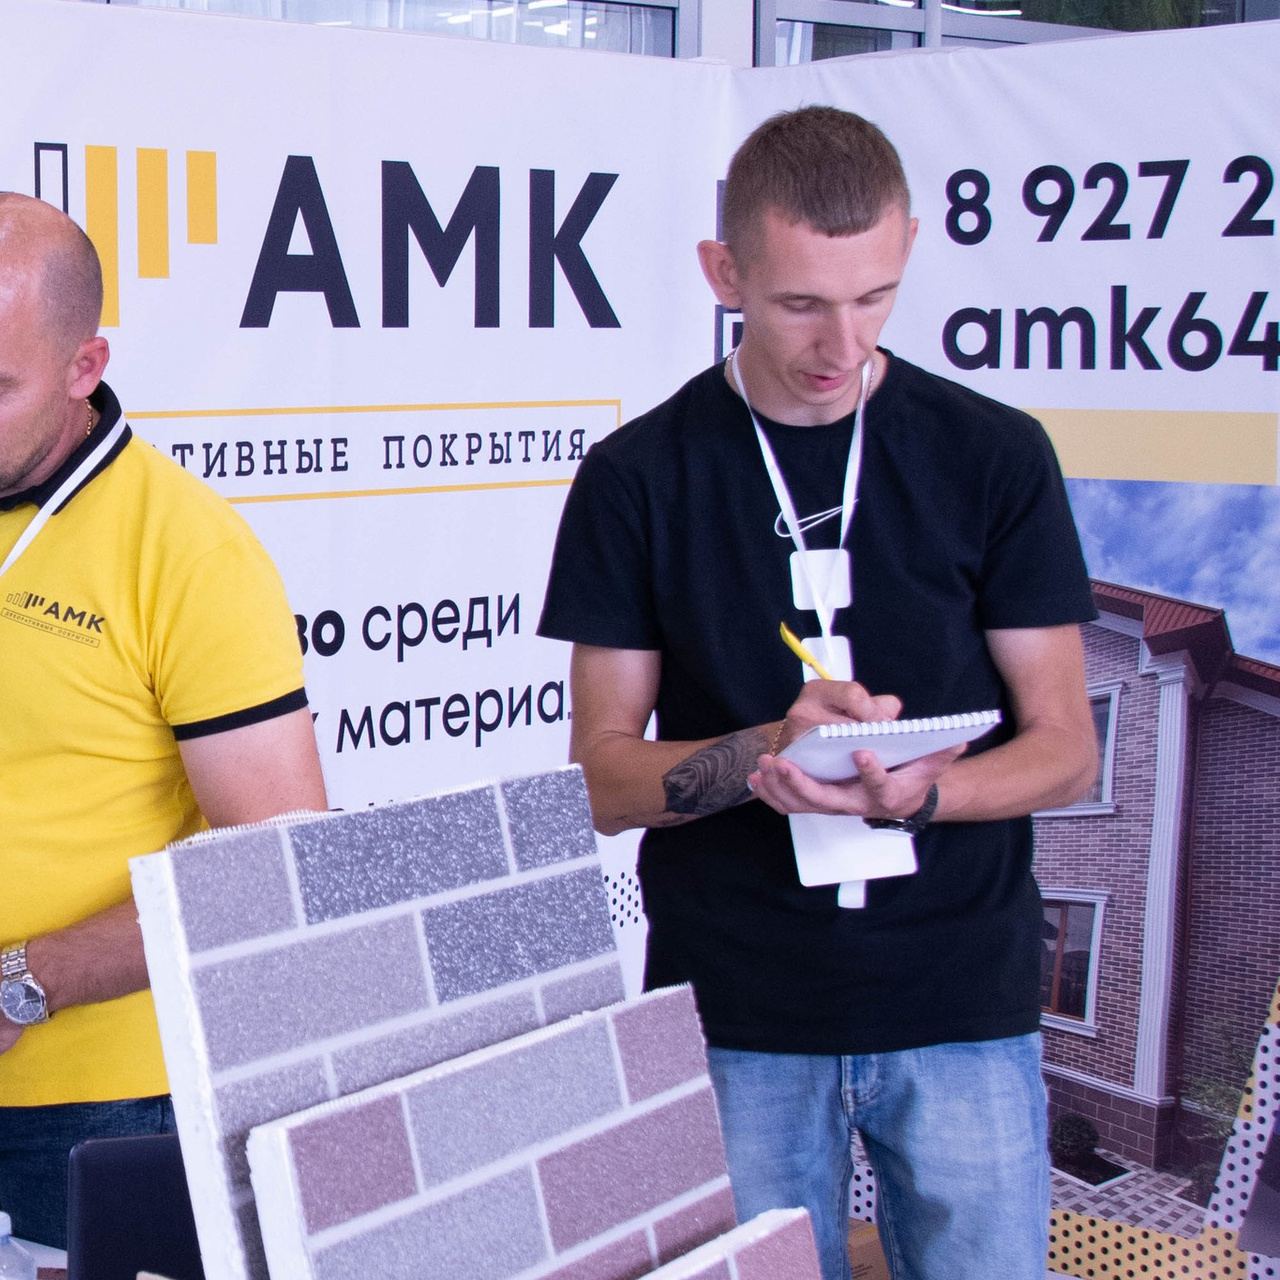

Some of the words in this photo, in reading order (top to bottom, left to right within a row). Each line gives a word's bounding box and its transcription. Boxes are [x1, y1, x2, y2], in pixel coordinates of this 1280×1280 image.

[945, 169, 992, 246] 8
[1022, 159, 1190, 243] 927
[1221, 155, 1275, 237] 2
[239, 155, 622, 328] АМК
[942, 285, 1279, 372] amk64
[383, 428, 586, 470] ПОКРЫТИЯ
[43, 601, 105, 634] АМК
[362, 593, 520, 663] среди
[336, 680, 573, 754] материа
